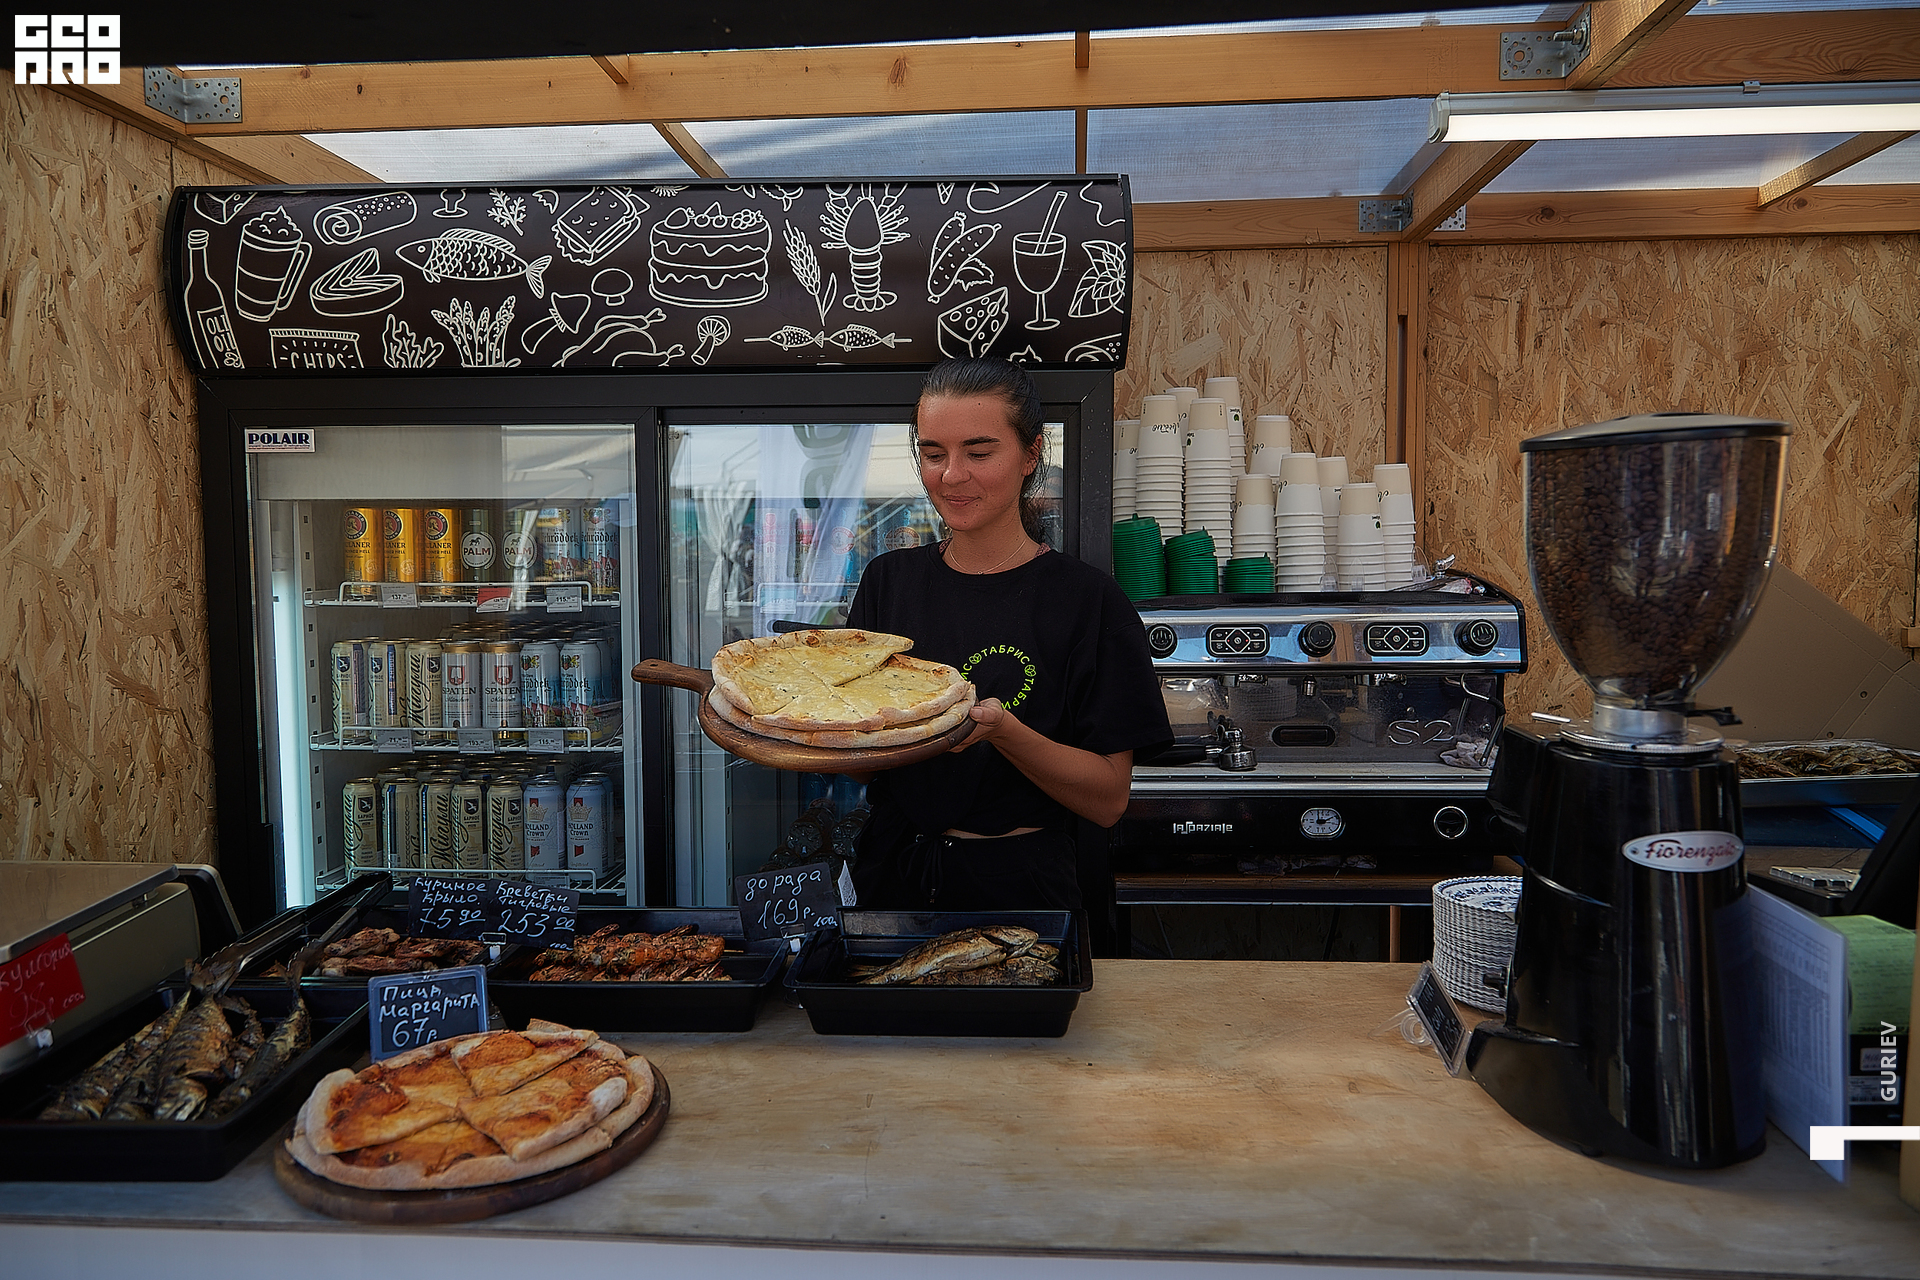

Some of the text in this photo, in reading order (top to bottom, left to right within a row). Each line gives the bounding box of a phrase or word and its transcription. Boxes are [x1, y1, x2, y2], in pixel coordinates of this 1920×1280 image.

[248, 433, 310, 444] POLAIR
[463, 547, 491, 555] PALM
[505, 547, 532, 555] PALM
[981, 644, 1031, 665] ТАБРИС
[442, 686, 477, 695] SPATEN
[485, 686, 521, 695] SPATEN
[1000, 678, 1035, 710] ТАБРИ
[1388, 719, 1454, 745] S2
[392, 1017, 430, 1047] 67
